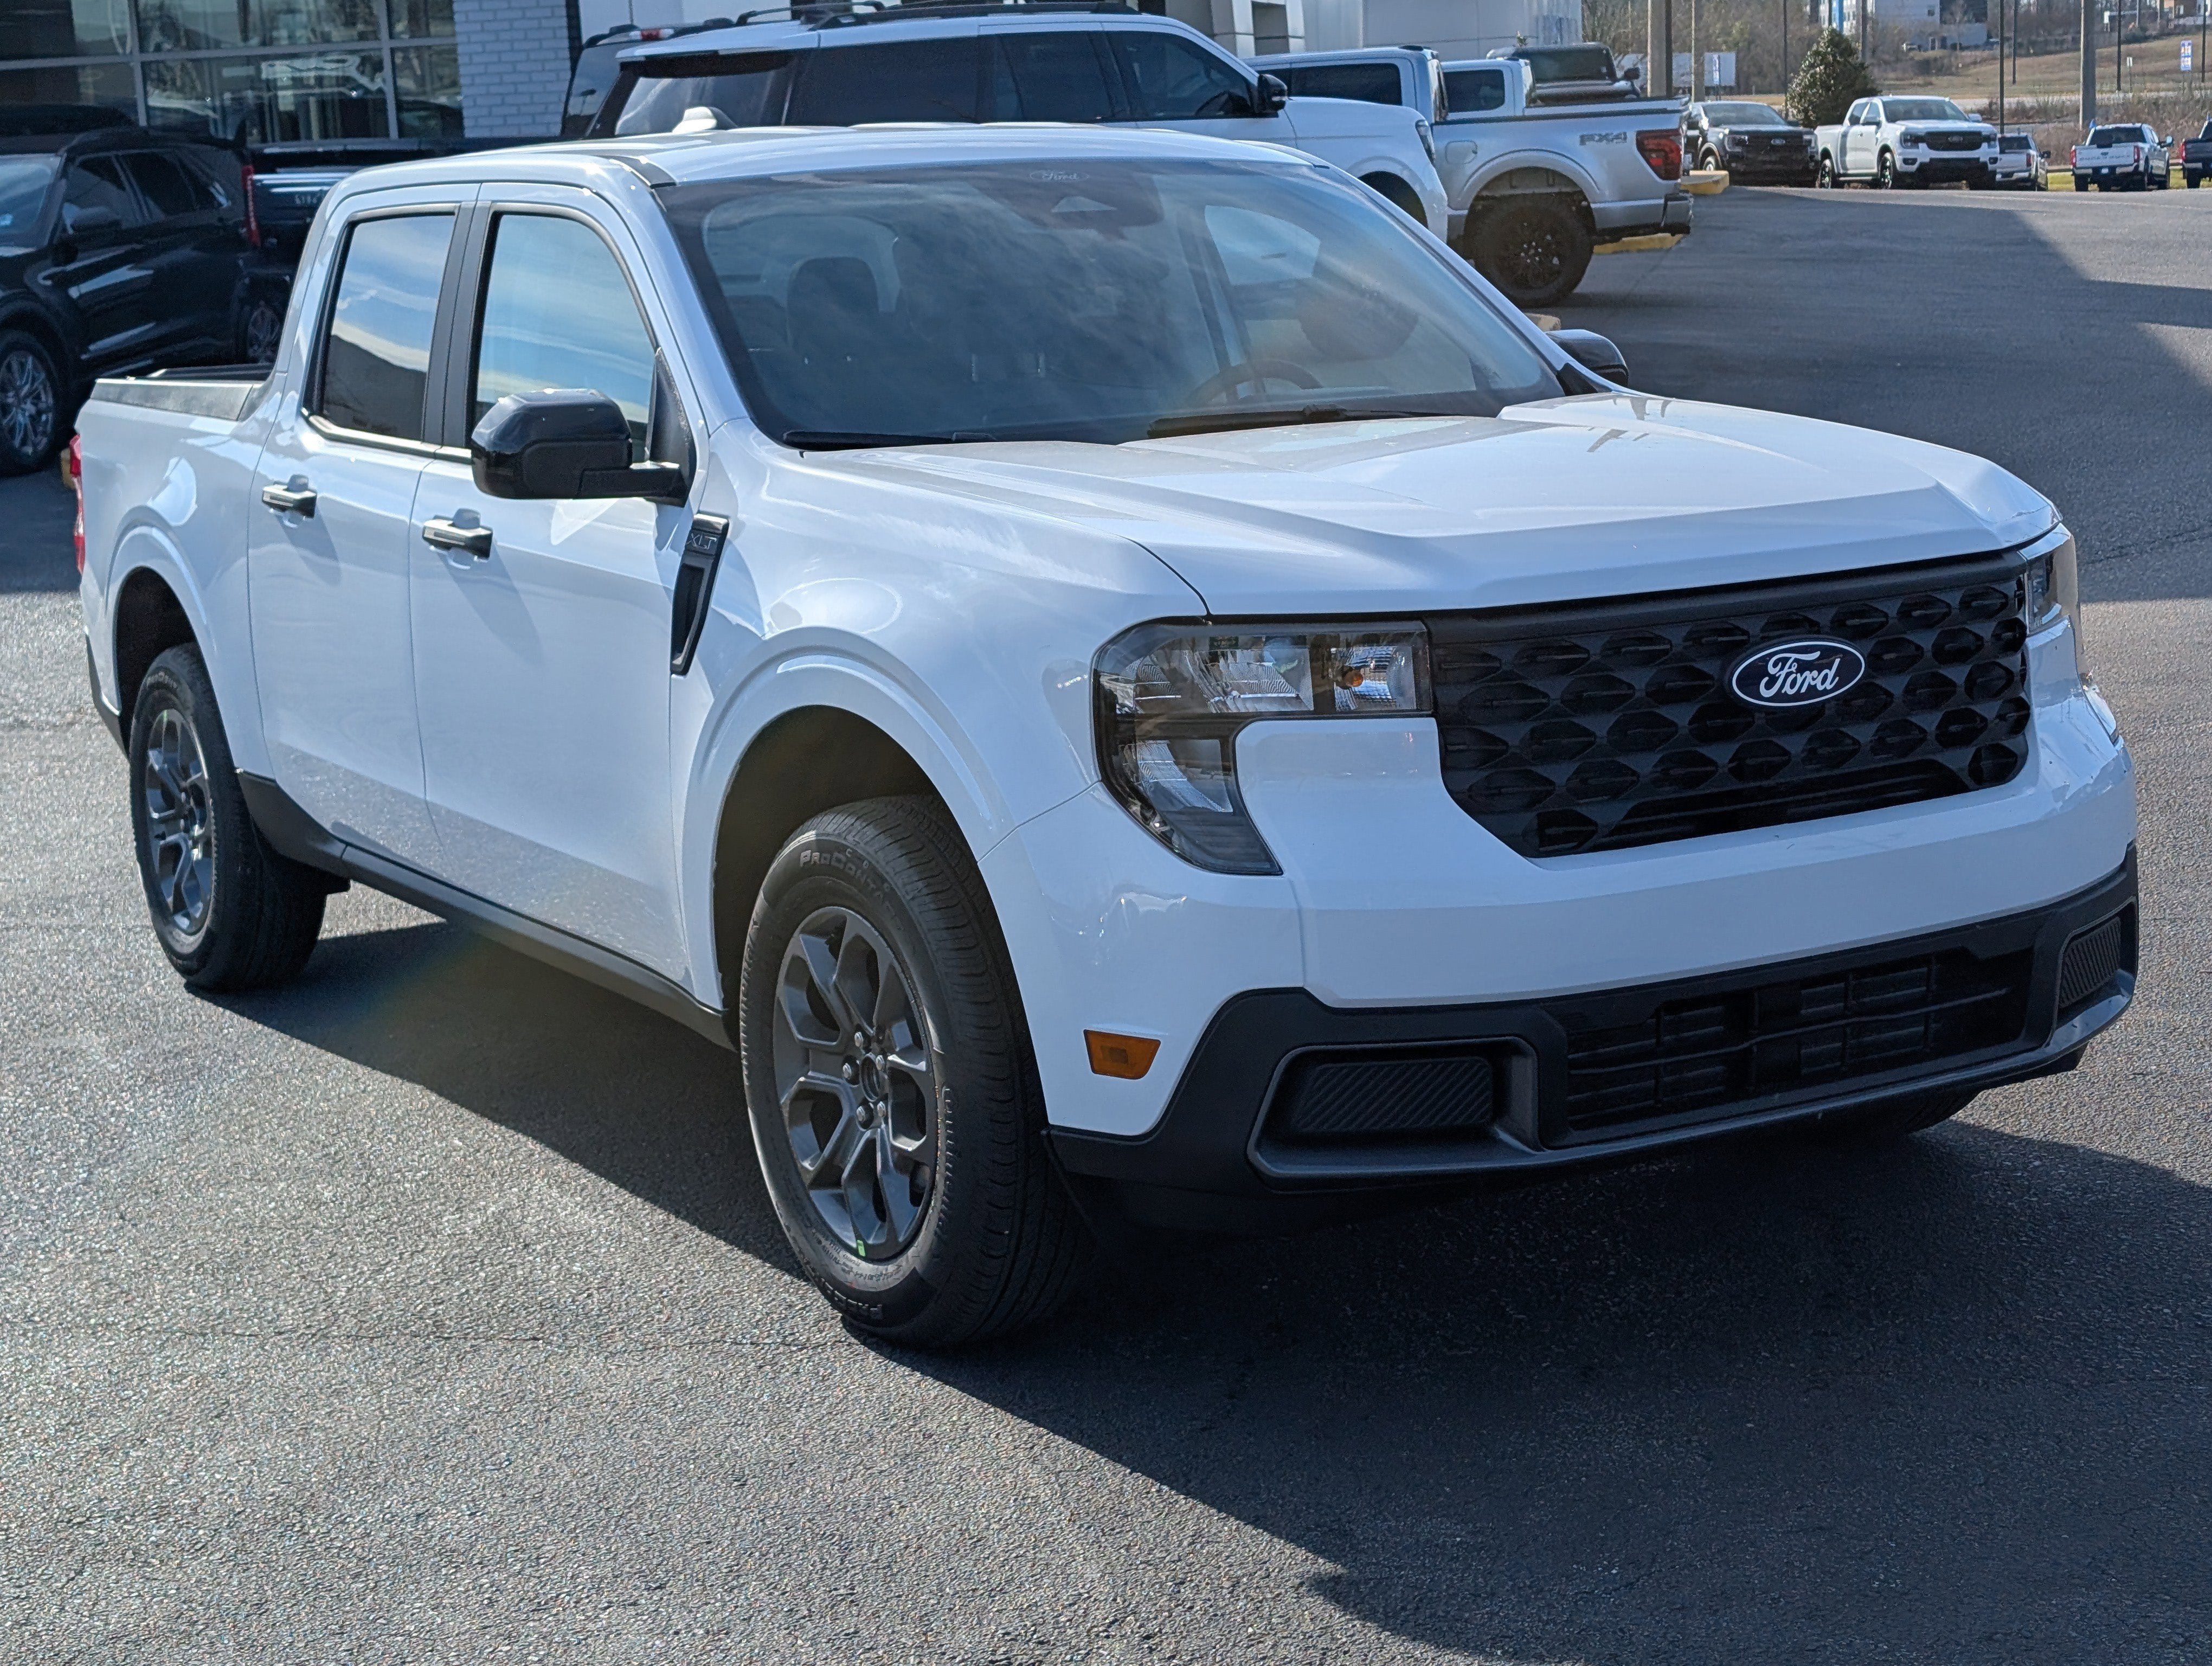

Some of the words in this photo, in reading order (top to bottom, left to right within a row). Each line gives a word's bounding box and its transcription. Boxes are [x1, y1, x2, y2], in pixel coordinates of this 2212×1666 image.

[1041, 172, 1078, 181] Ford
[687, 533, 717, 550] XLT
[1760, 651, 1841, 697] Ford
